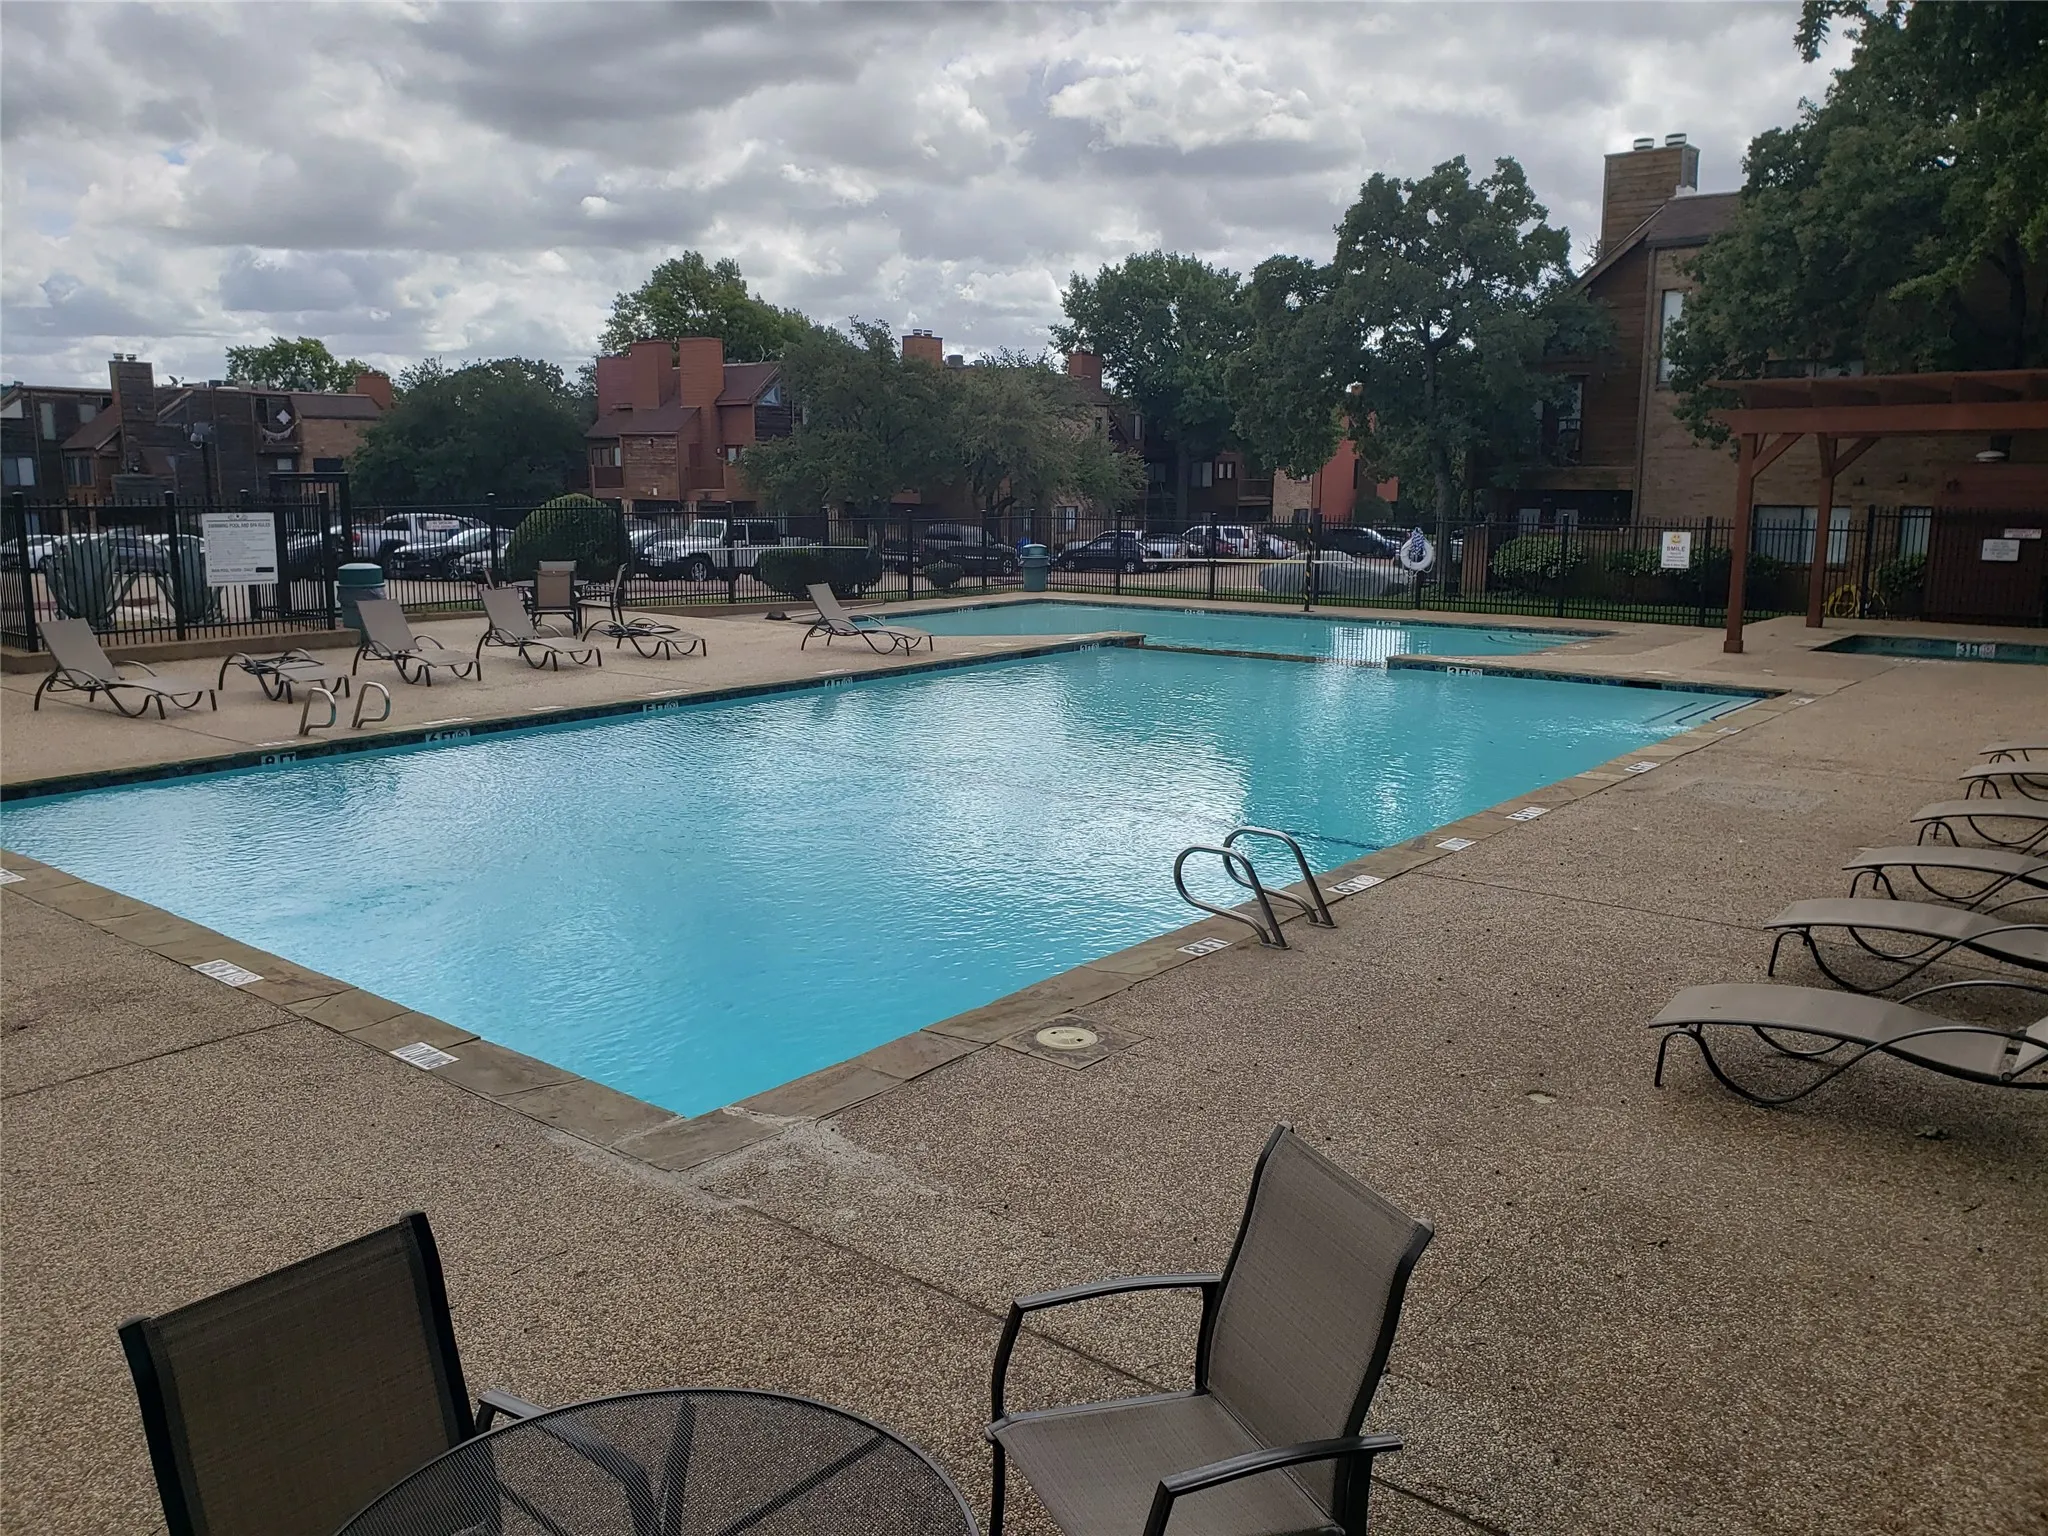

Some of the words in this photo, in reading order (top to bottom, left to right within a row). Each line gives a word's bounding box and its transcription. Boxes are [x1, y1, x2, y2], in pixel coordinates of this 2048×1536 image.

[1342, 880, 1370, 890] FT
[1183, 945, 1210, 954] 8
[1197, 938, 1227, 949] FT
[197, 961, 228, 972] 8
[208, 965, 246, 978] FT
